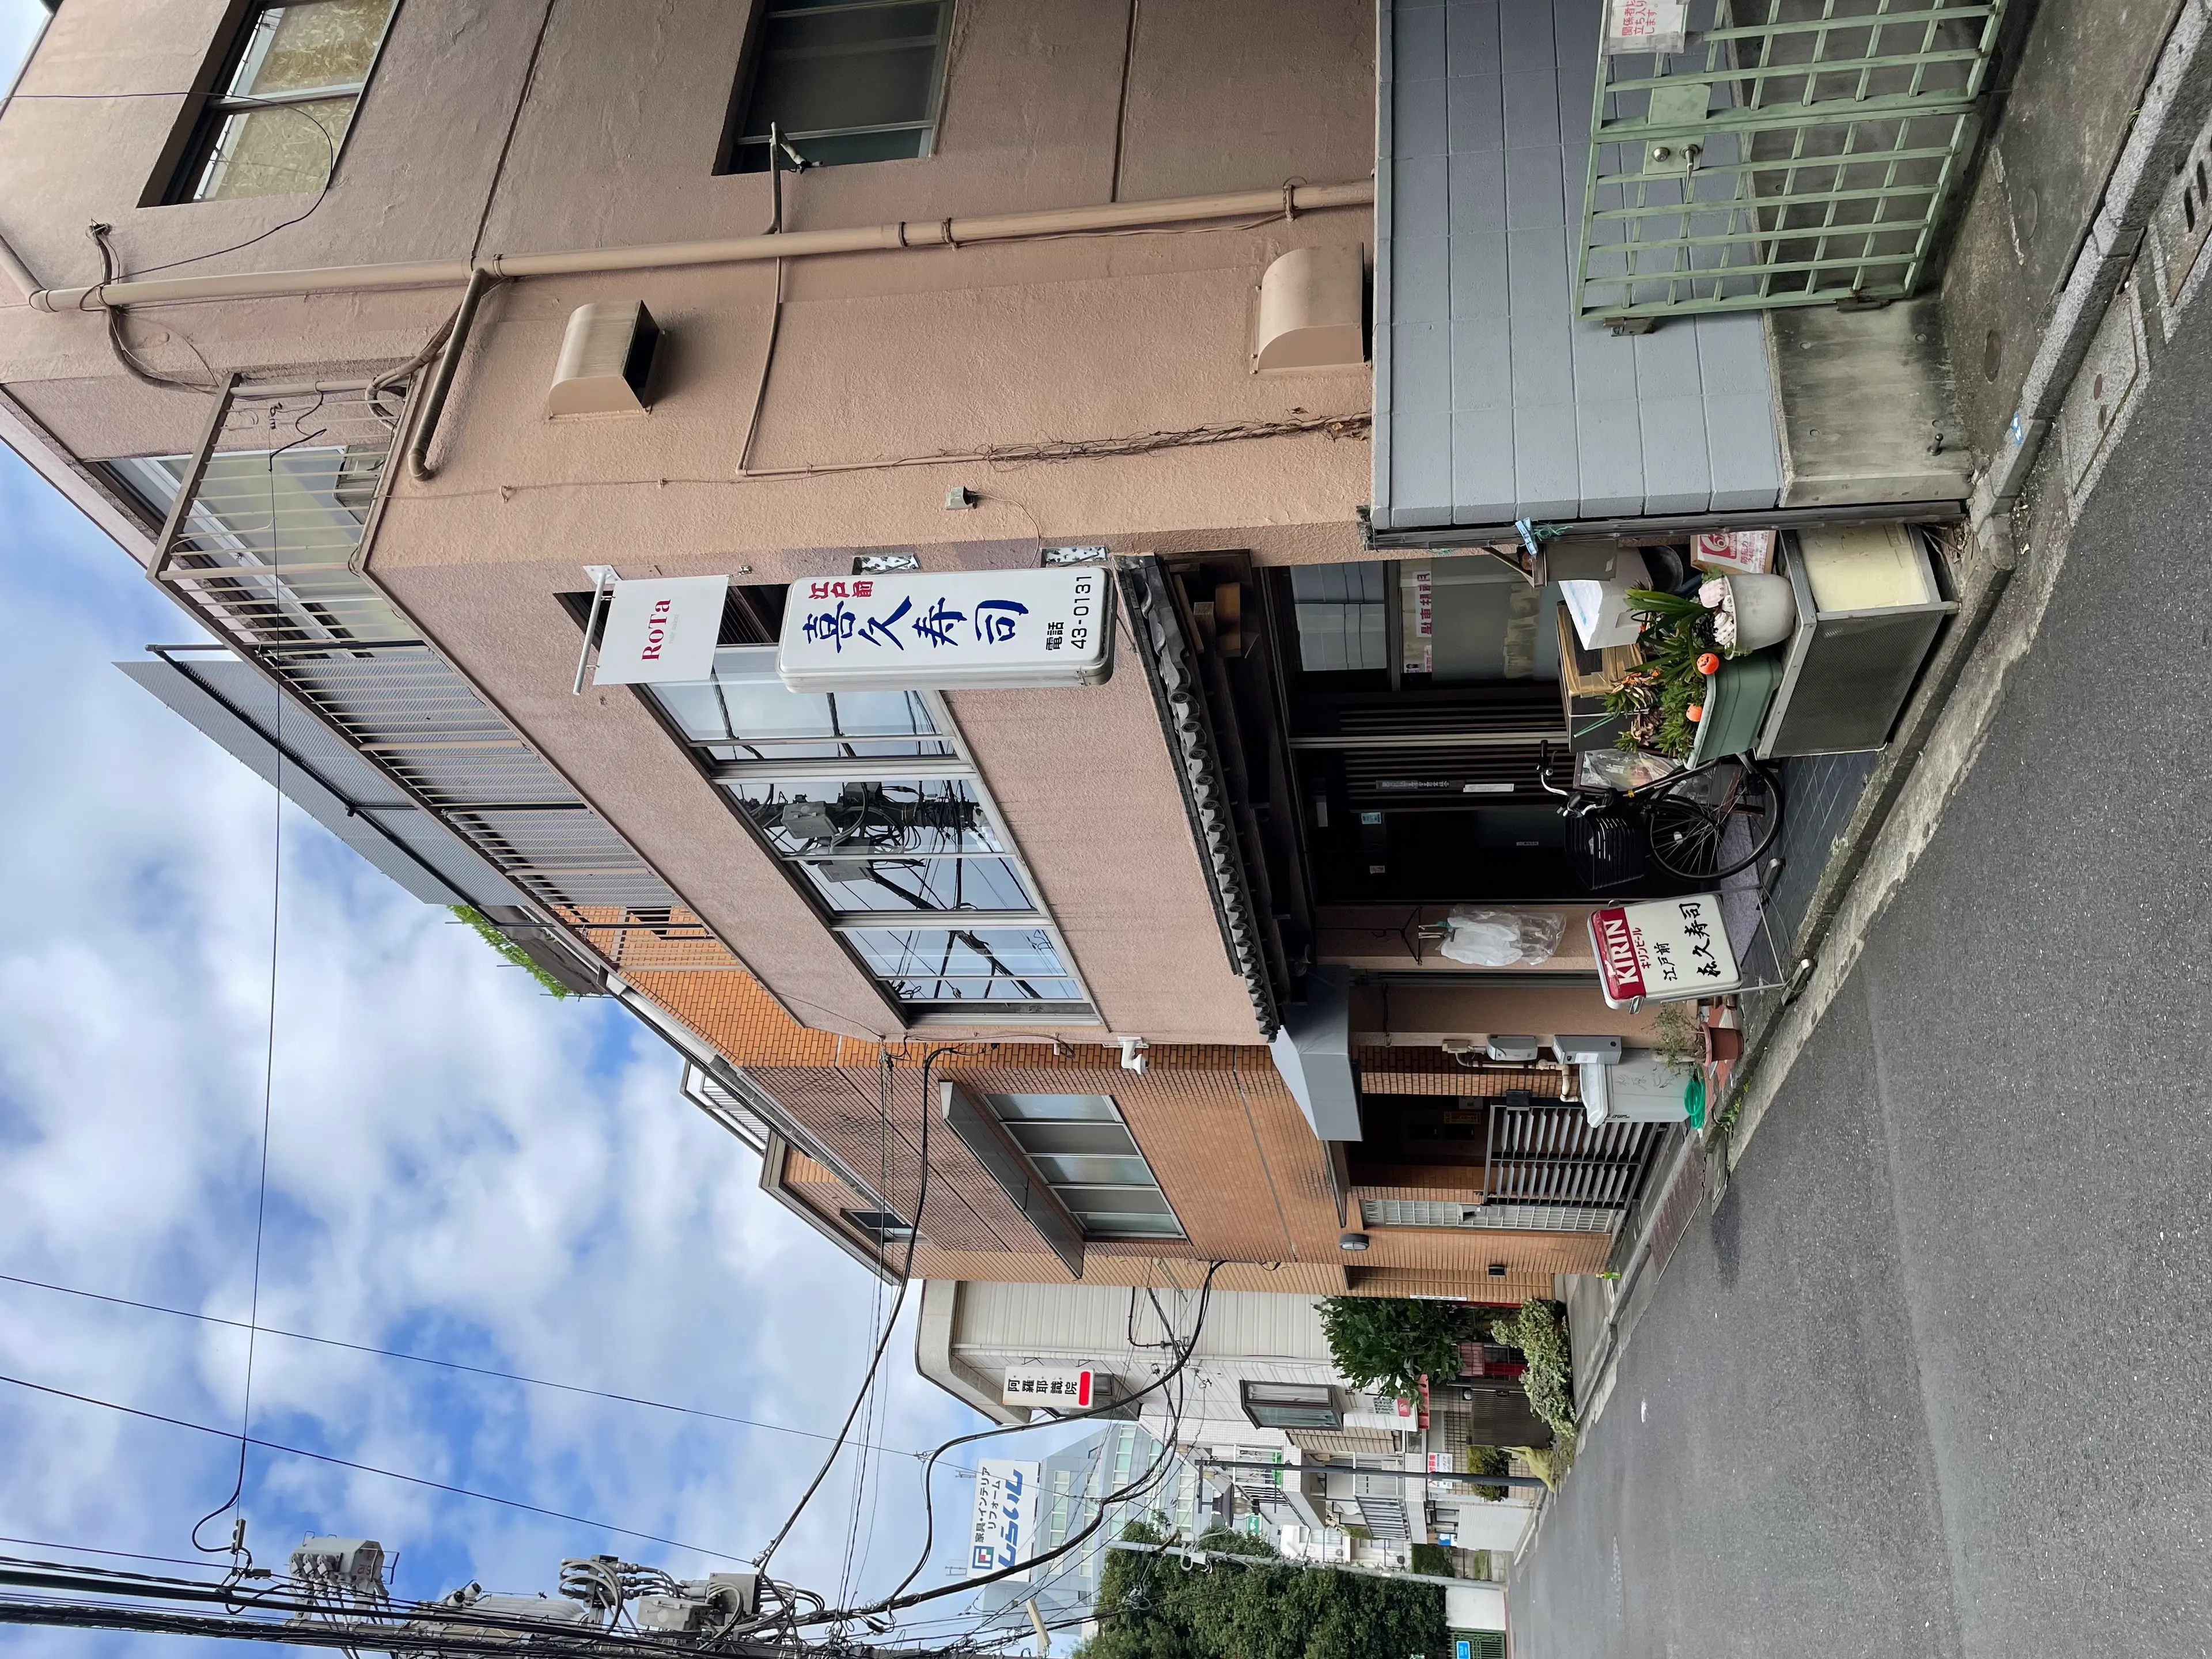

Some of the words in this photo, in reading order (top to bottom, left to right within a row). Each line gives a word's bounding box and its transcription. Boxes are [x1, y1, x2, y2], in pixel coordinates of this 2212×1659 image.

[808, 580, 874, 600] 江戸前
[1070, 576, 1092, 650] 43-0131
[641, 599, 671, 661] RoTa
[802, 595, 1029, 653] 喜久寿司
[1046, 622, 1064, 651] 電話
[1602, 918, 1639, 986] KIRIN
[1633, 927, 1652, 969] キリンビール
[1653, 942, 1678, 982] 江戸前
[1007, 1378, 1077, 1395] 阿羅耶識院
[975, 1467, 991, 1543] 家具・インテリア
[987, 1480, 1001, 1529] リフォーム
[998, 1468, 1023, 1567] しらいし
